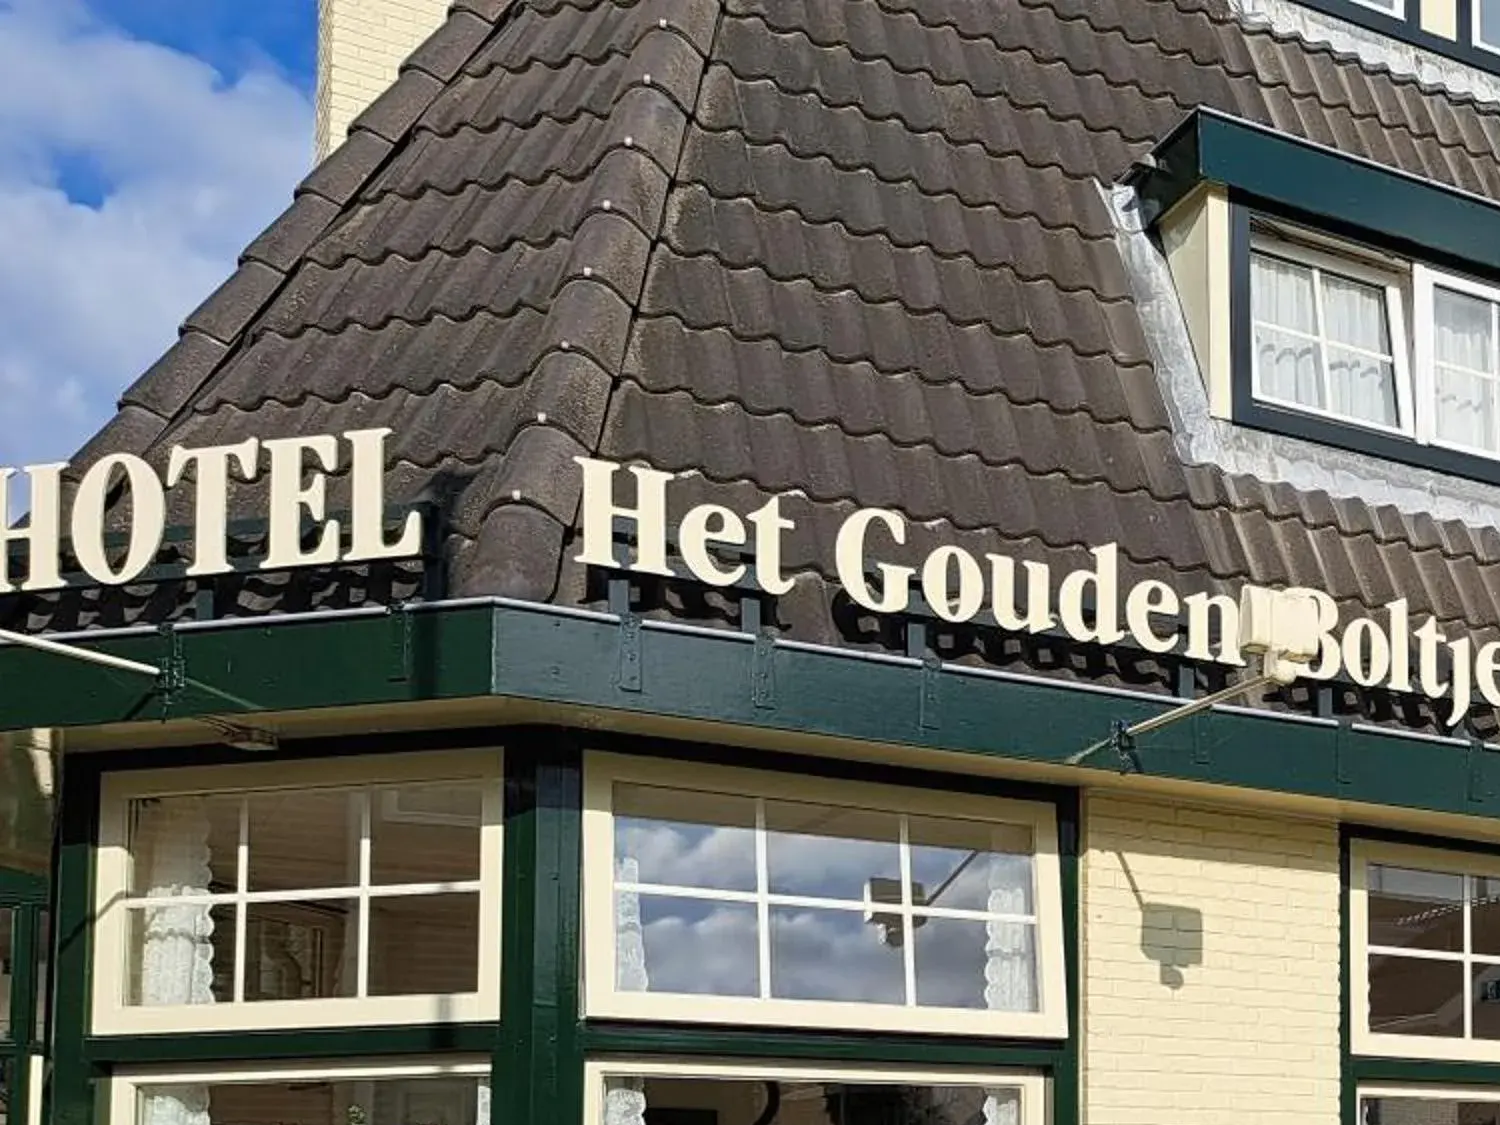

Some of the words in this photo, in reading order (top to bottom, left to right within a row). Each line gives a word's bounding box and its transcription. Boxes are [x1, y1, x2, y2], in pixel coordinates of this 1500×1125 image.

[0, 427, 423, 593] HOTEL
[573, 454, 797, 596] Het
[834, 506, 1247, 668] Gouden
